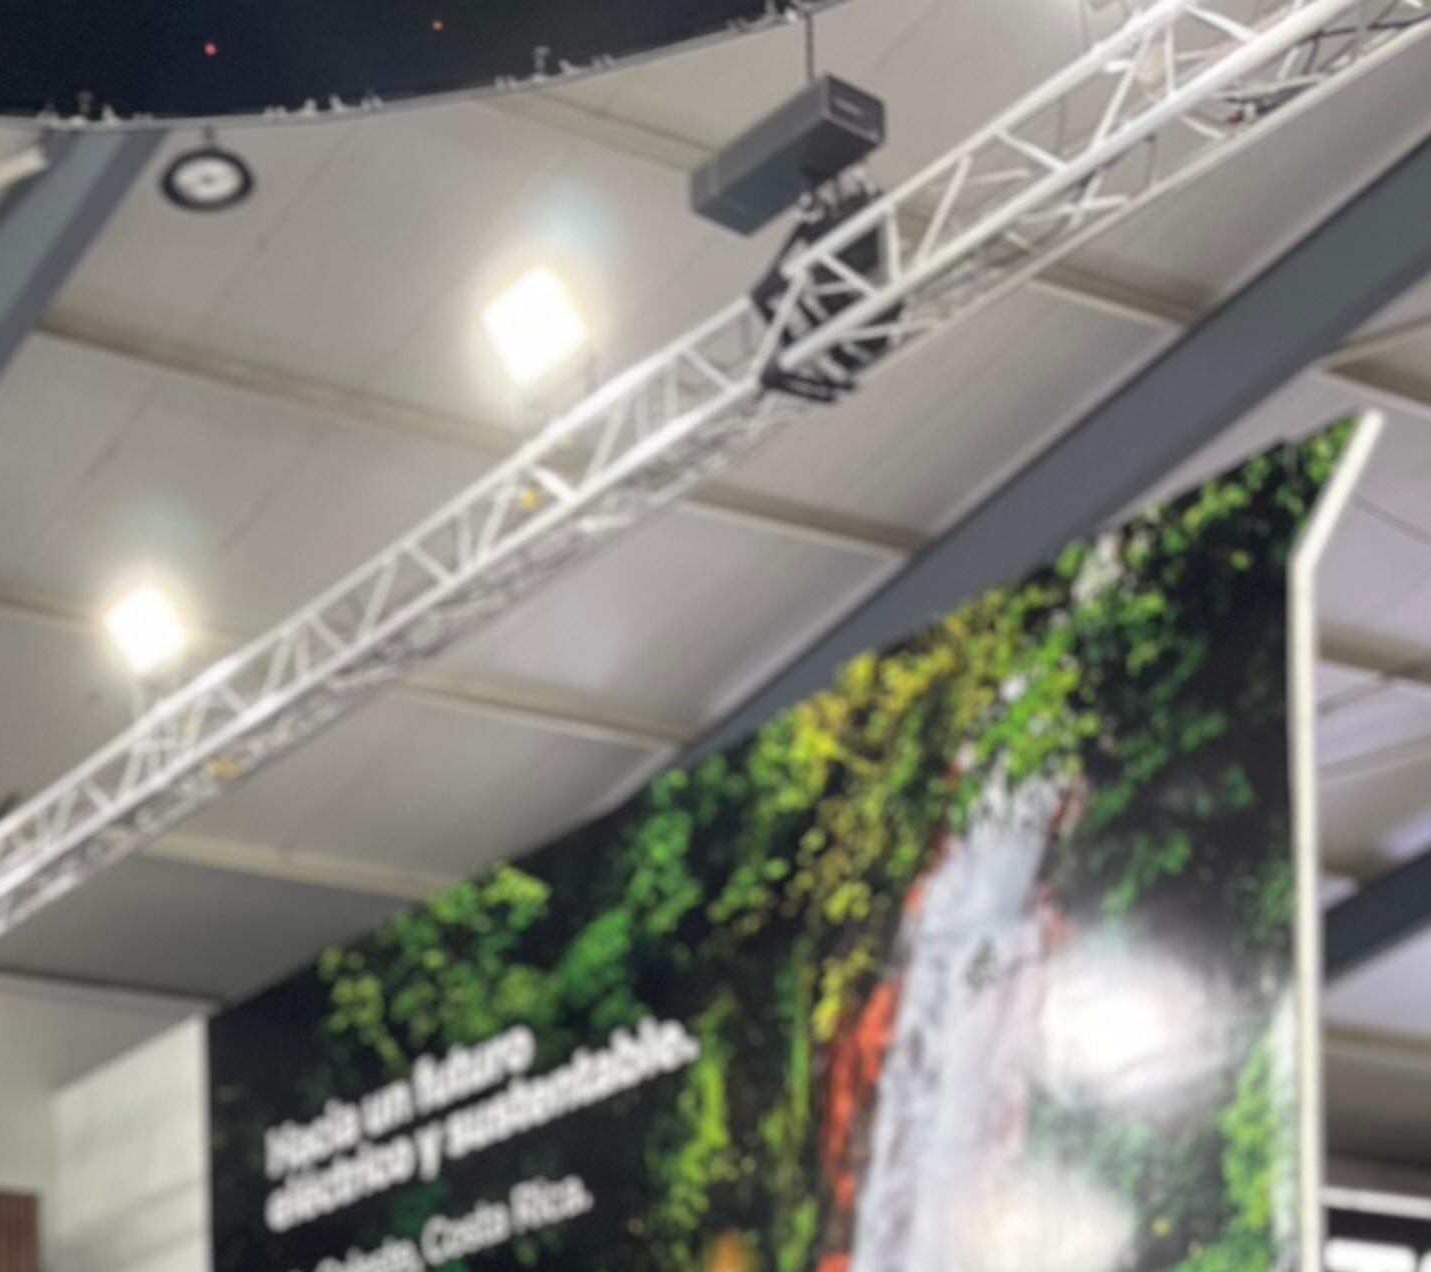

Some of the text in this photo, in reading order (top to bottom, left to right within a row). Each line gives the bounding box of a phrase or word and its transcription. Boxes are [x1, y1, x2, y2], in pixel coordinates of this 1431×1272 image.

[267, 1026, 535, 1177] Hacia un futuro
[417, 1124, 442, 1181] y
[422, 1201, 509, 1265] Costa
